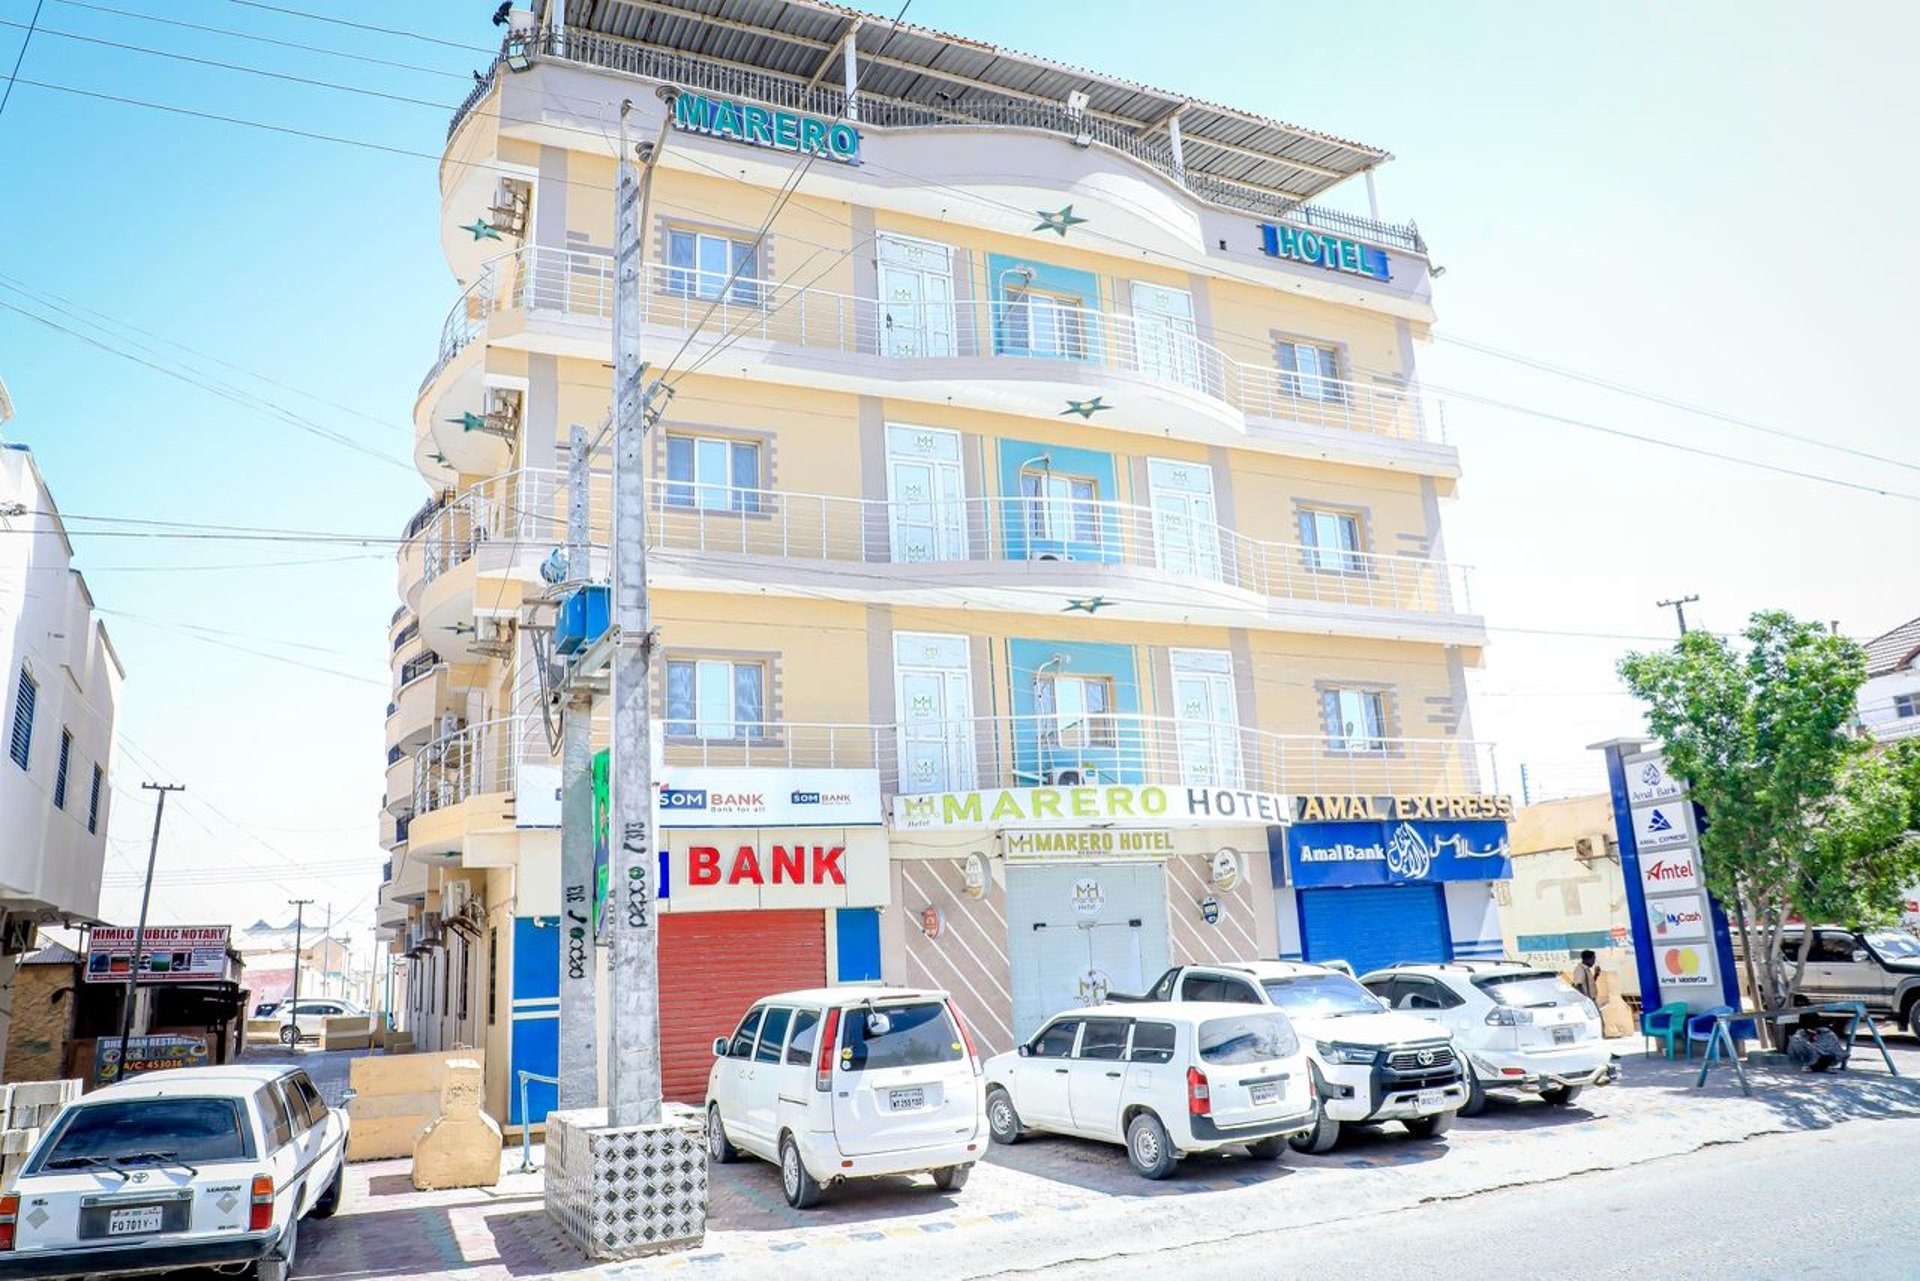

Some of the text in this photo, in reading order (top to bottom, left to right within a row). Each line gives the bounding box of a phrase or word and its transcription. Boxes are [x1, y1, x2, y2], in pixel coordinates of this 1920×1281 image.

[675, 90, 858, 162] MARERO
[1277, 225, 1375, 276] HOTEL
[660, 792, 765, 806] SOM BANK
[793, 795, 819, 804] SOM
[821, 794, 851, 802] BANK
[1632, 784, 1678, 800] Amal Bank
[711, 806, 733, 814] Bank
[754, 805, 765, 813] all
[943, 786, 1168, 825] MARERO
[1188, 789, 1290, 823] HOTEL
[1303, 796, 1513, 820] AMAL EXPRESS
[1035, 832, 1114, 852] MARERO
[1120, 831, 1174, 850] HOTEL
[1301, 844, 1387, 863] Amal Bank
[688, 846, 846, 887] BANK
[1644, 860, 1694, 881] Amtel
[1666, 911, 1702, 926] MyCash
[92, 928, 225, 940] HIMILO UBLIC NOTARY
